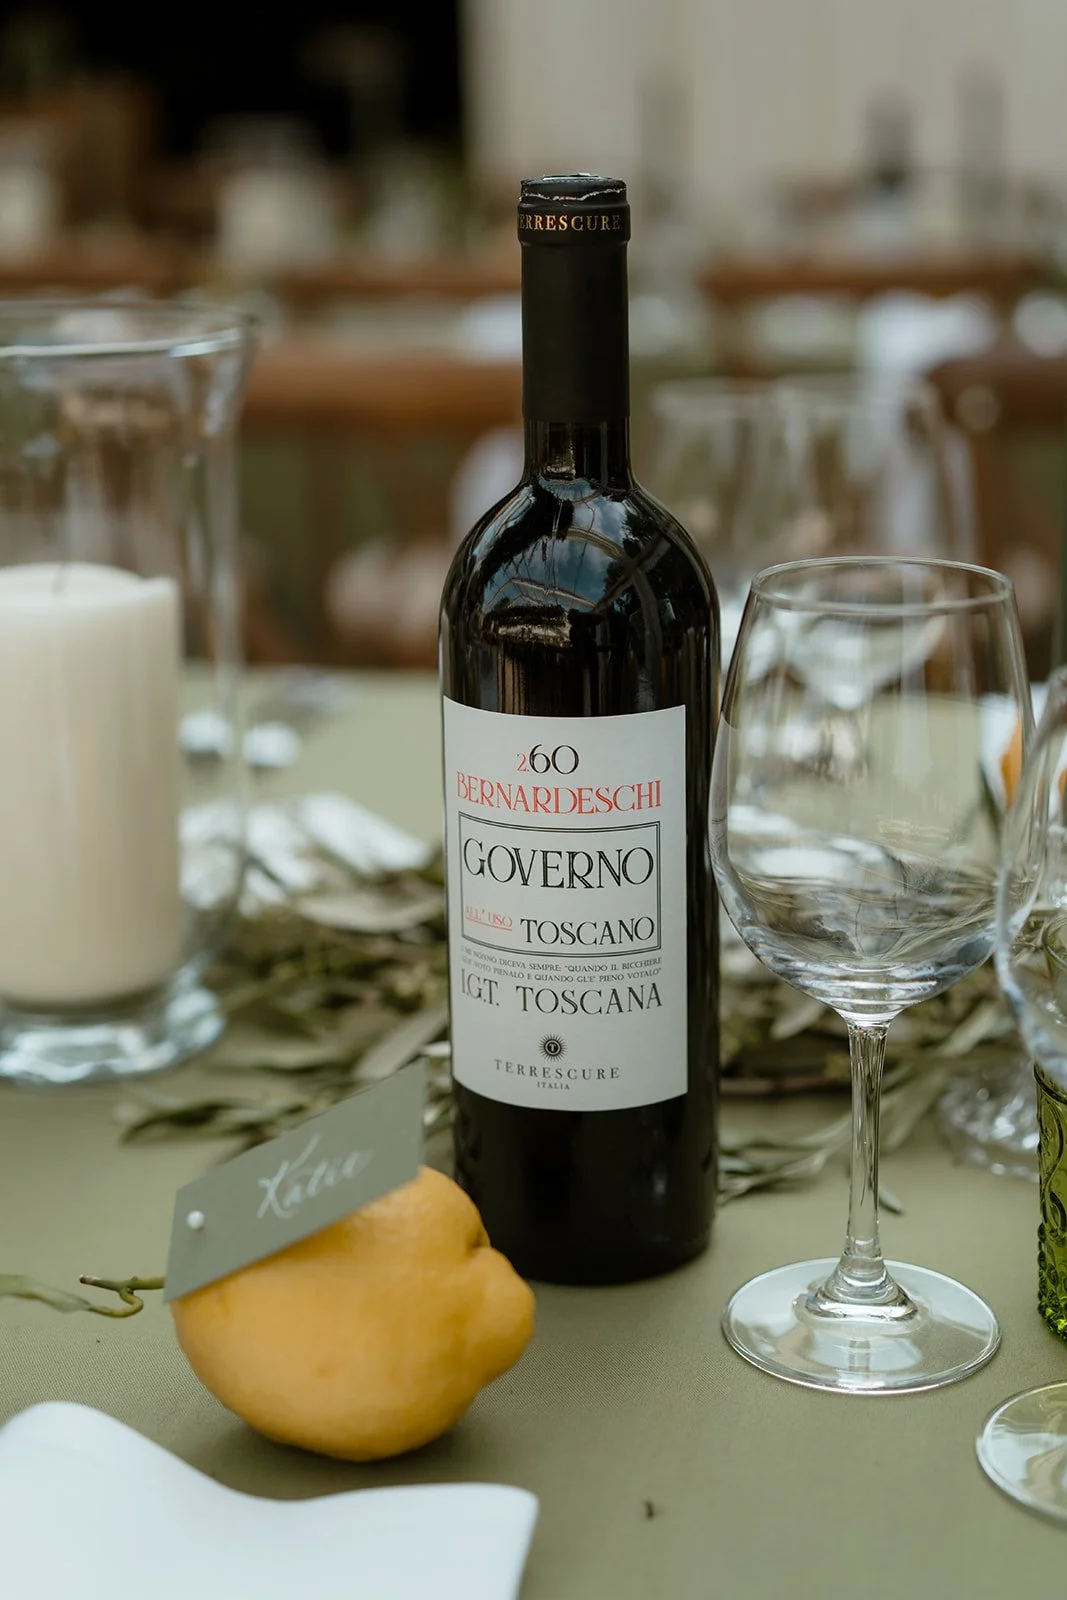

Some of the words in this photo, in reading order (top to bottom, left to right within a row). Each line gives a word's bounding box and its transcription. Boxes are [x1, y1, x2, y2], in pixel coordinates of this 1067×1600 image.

[519, 213, 621, 231] ERRESCURE
[457, 771, 661, 814] BERNARDESCHI
[463, 838, 654, 889] GOVERNO
[488, 912, 513, 928] USO
[520, 916, 655, 945] TOSCANO
[499, 958, 527, 970] DICEVA
[622, 957, 662, 970] BICCHIERE
[534, 974, 574, 983] QUANDO
[599, 973, 625, 982] PIENO
[515, 982, 663, 1015] TOSCANA
[494, 1059, 620, 1080] TERRESCURE
[537, 1081, 570, 1090] ITALIA
